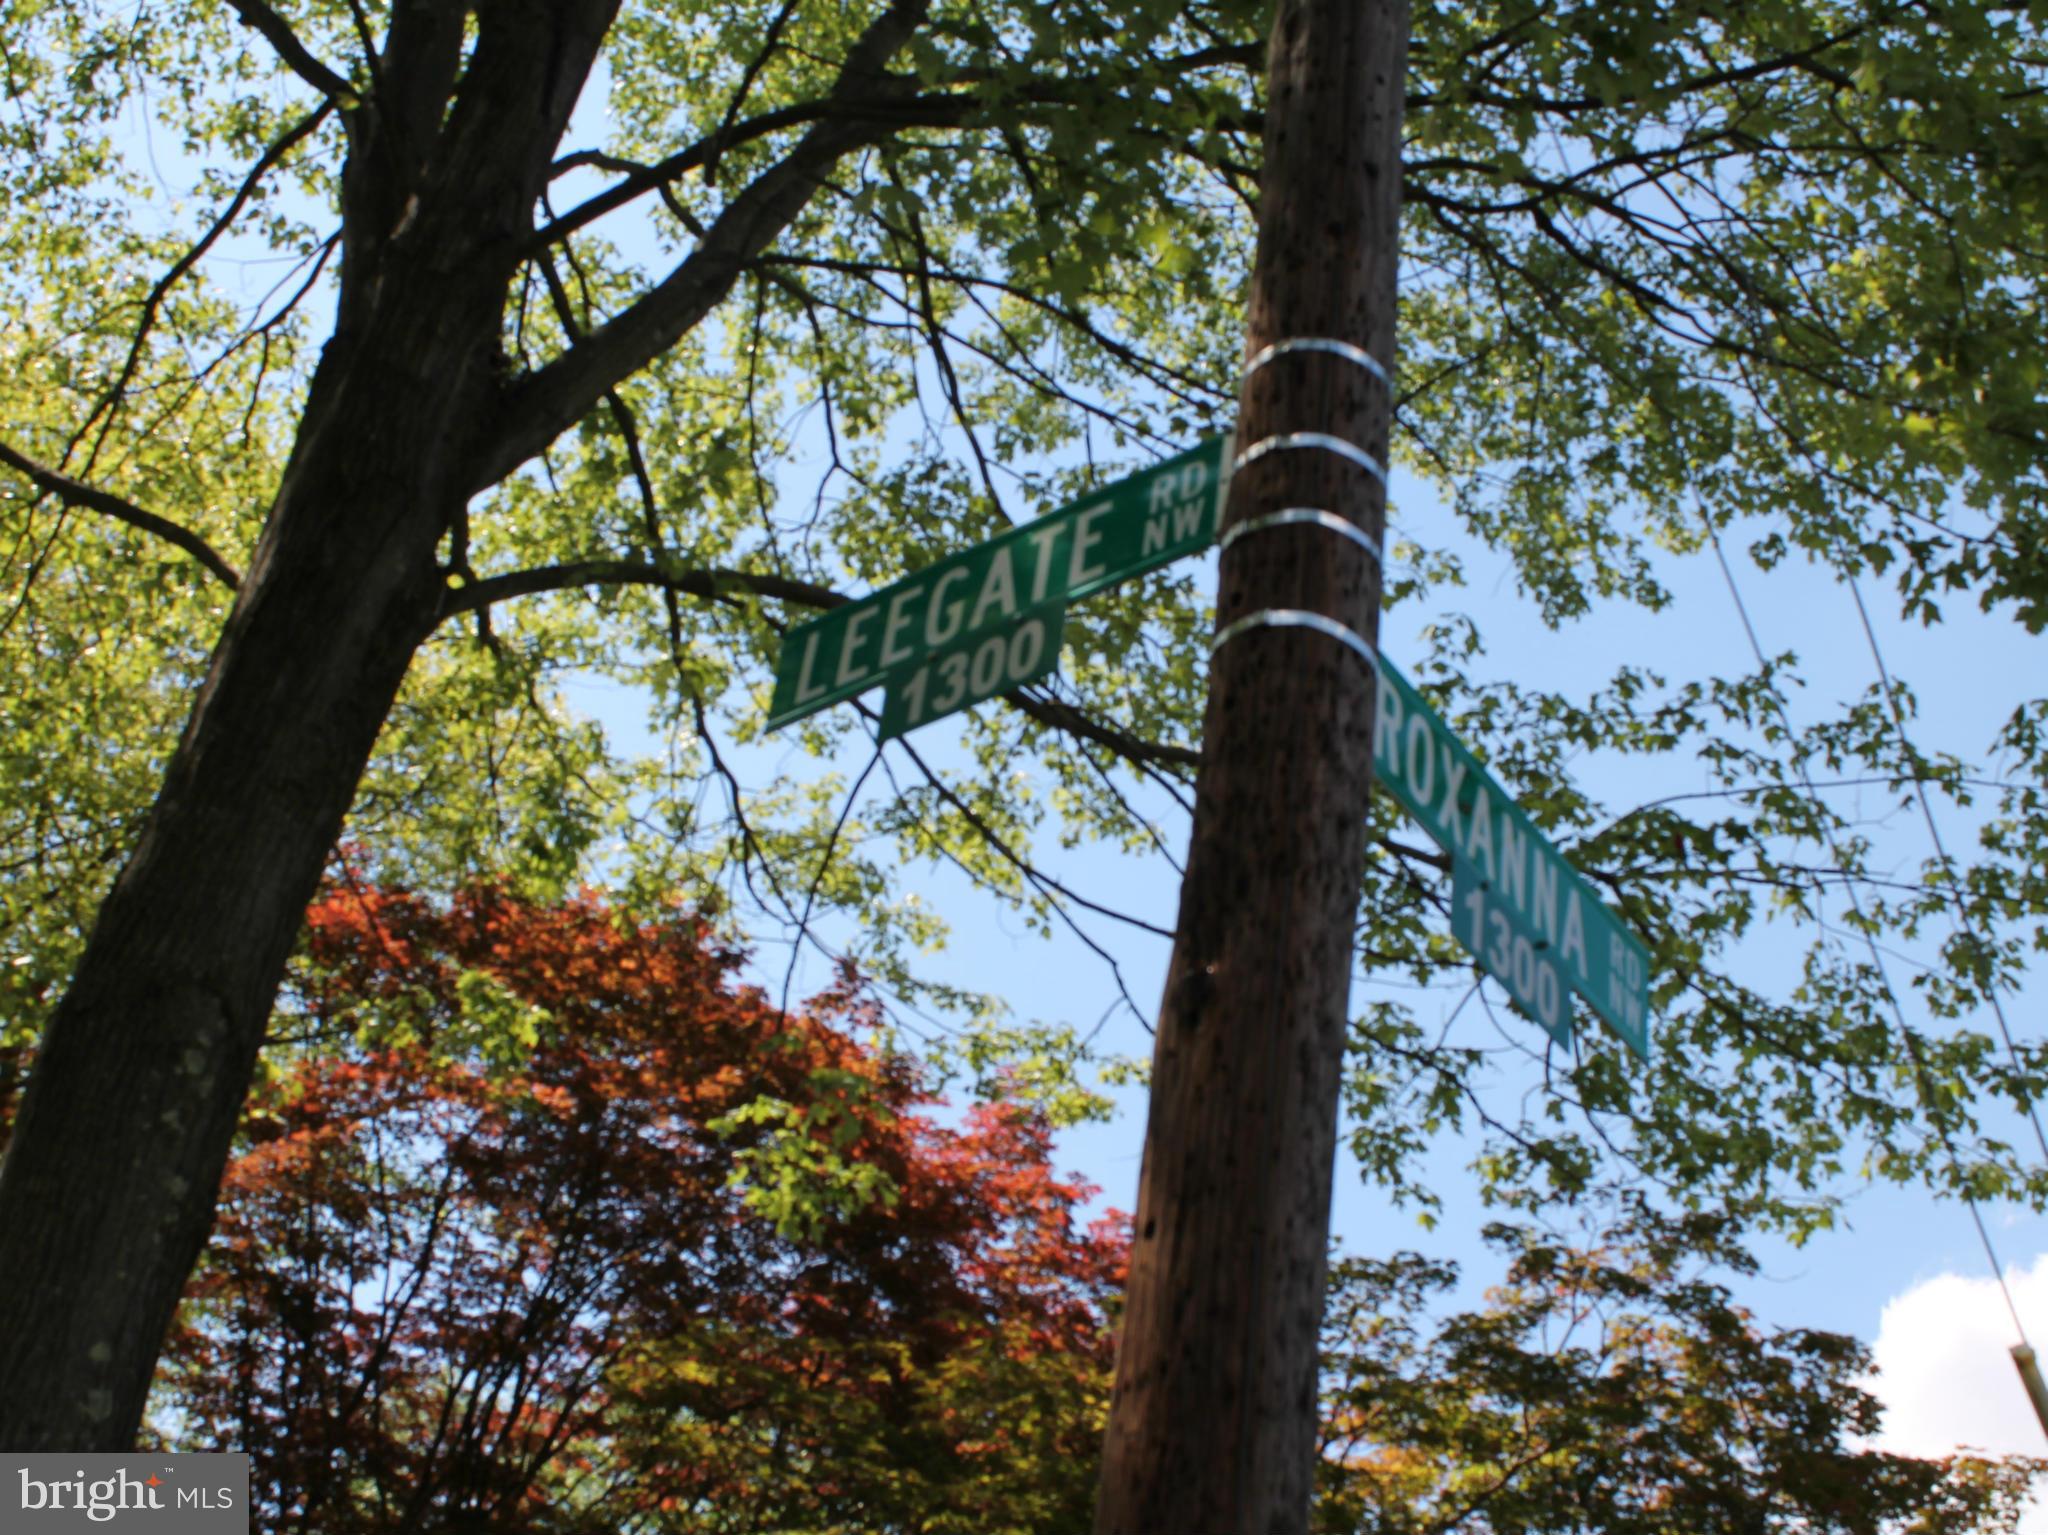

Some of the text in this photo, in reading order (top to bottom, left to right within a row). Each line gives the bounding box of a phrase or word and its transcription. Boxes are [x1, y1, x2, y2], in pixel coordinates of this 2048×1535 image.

[1140, 501, 1205, 557] NW
[1148, 460, 1206, 514] RD
[793, 501, 1113, 702] LEEGATE
[902, 619, 1046, 725] 1300
[1375, 669, 1588, 980] ROXANNA
[1465, 888, 1559, 1027] 1300
[1609, 931, 1641, 992] RD
